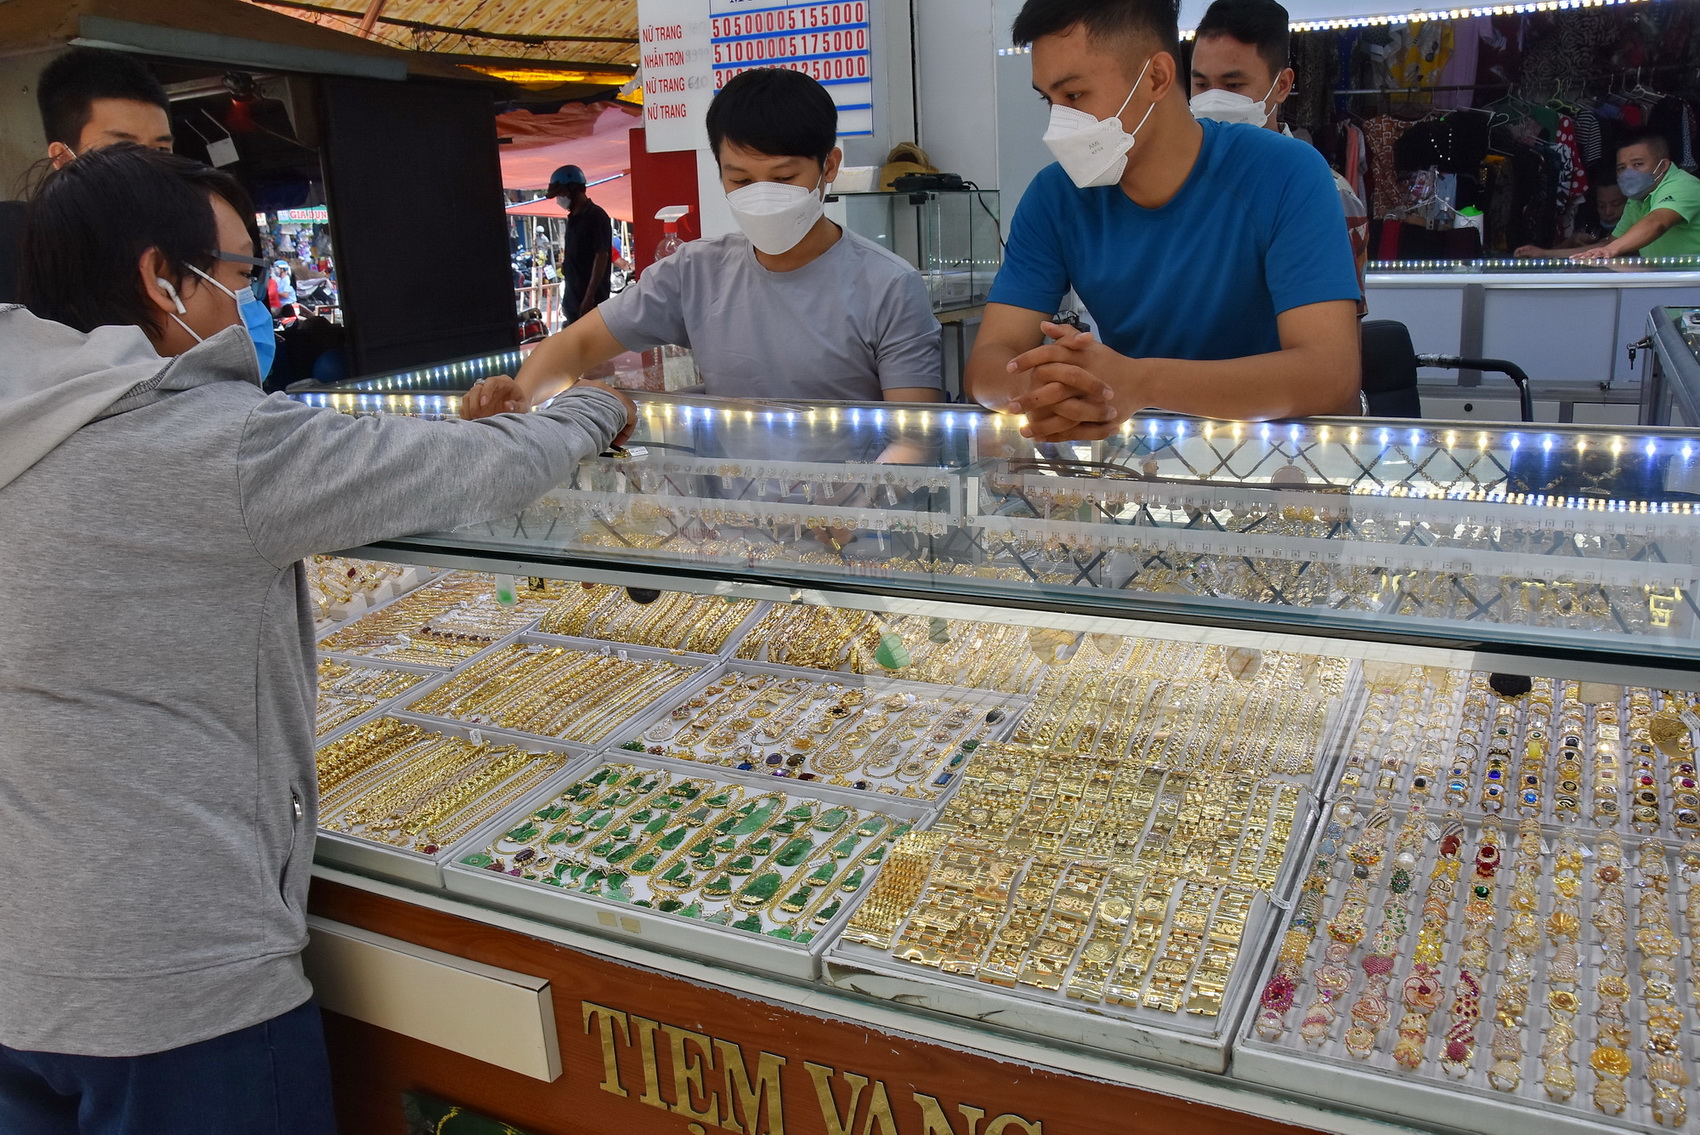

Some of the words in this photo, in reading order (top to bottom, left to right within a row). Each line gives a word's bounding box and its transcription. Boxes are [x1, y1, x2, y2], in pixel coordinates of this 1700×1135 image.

[655, 24, 682, 42] TRANG
[658, 77, 685, 93] TRANG
[660, 103, 686, 119] TRANG
[289, 210, 307, 219] GIA
[803, 1060, 1042, 1135] VA
